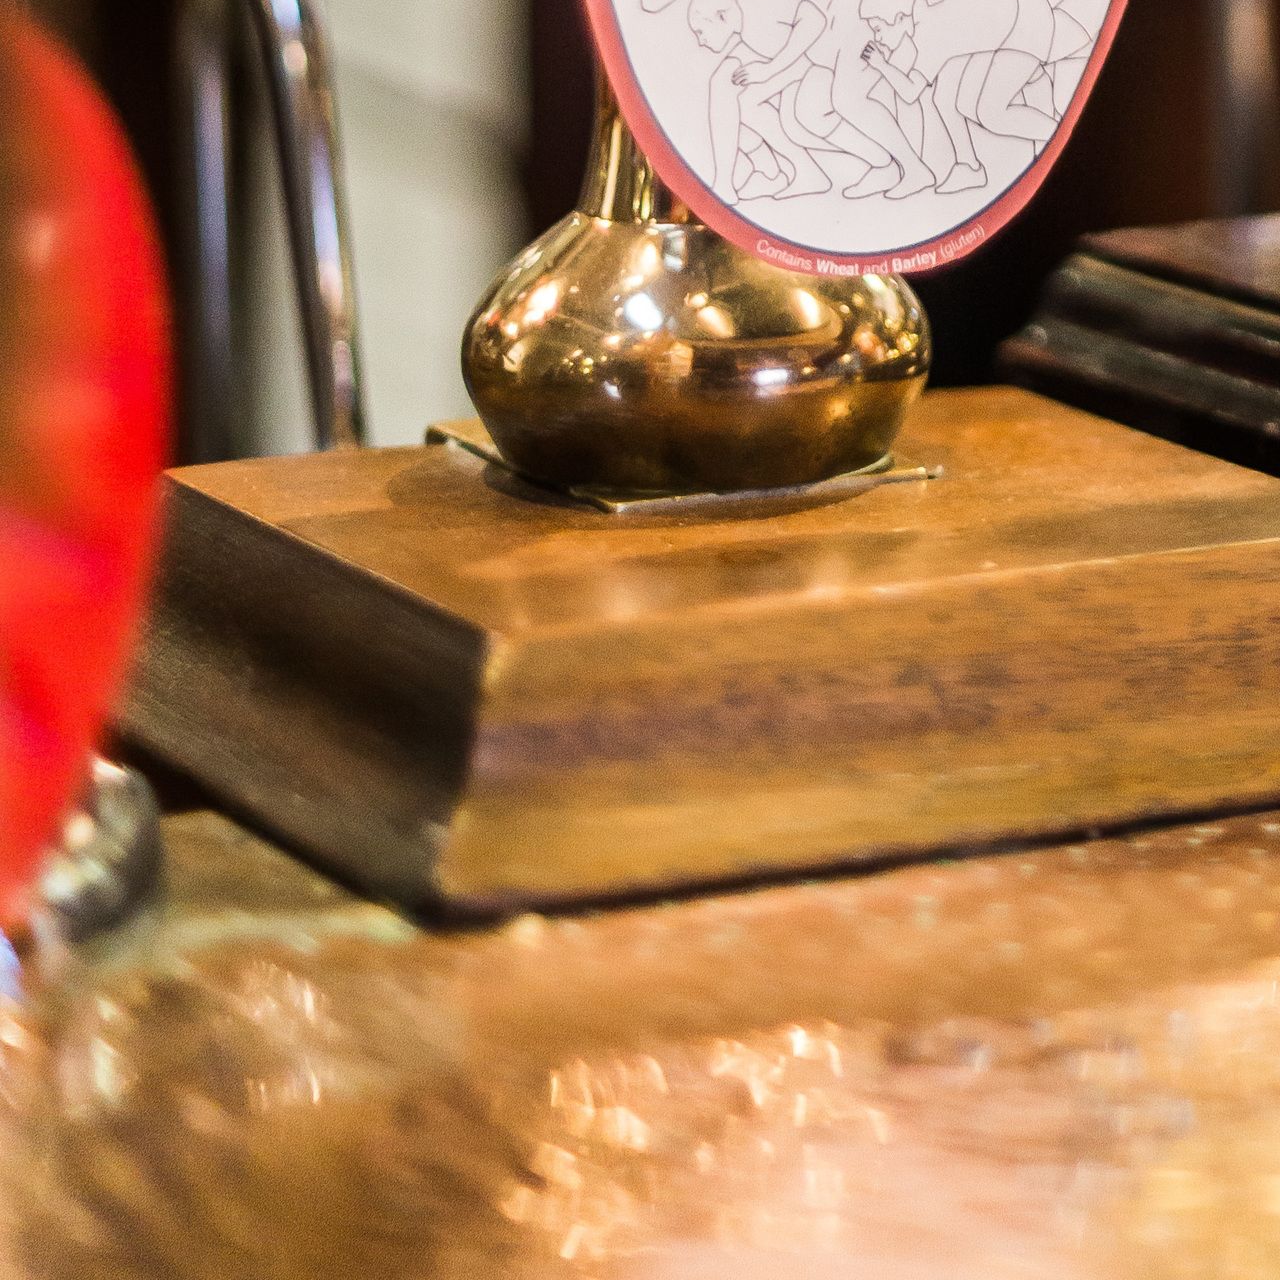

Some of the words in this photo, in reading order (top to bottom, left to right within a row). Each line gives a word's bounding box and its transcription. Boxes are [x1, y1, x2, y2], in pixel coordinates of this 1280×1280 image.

[755, 238, 814, 273] Contains
[816, 257, 860, 277] Wheat
[862, 256, 889, 275] and
[891, 249, 938, 275] Barley
[940, 222, 987, 262] (gluten)
